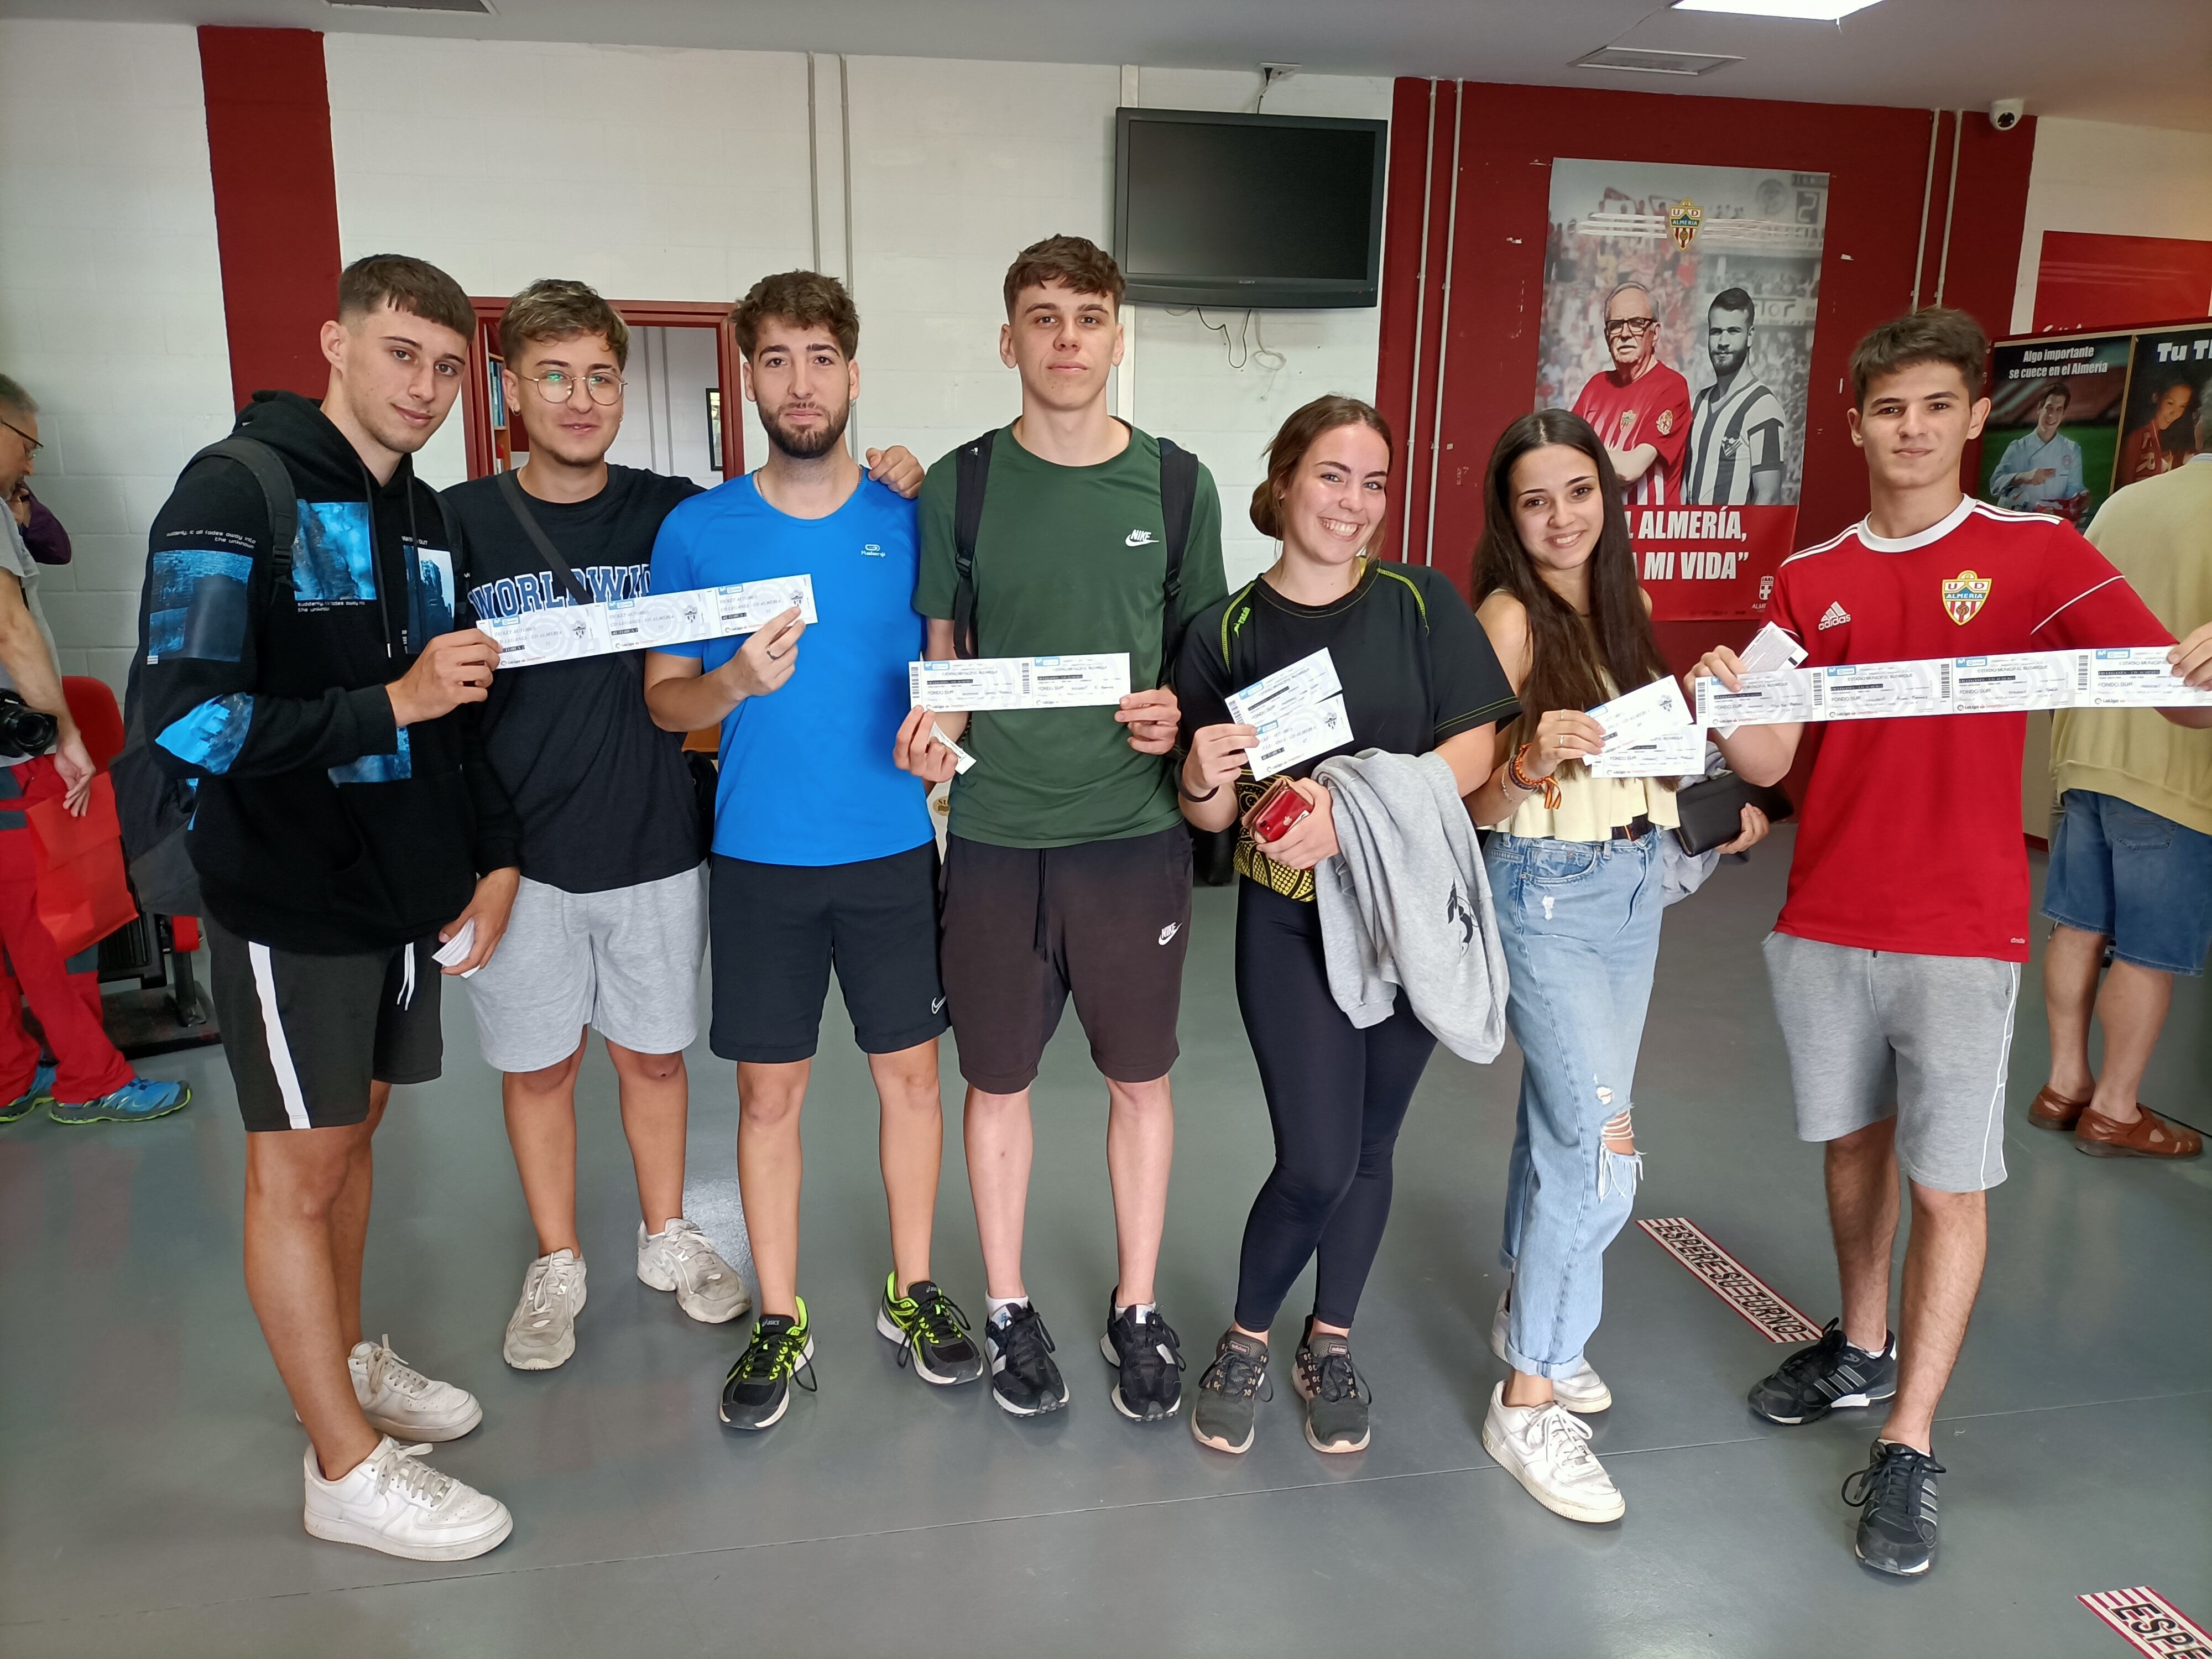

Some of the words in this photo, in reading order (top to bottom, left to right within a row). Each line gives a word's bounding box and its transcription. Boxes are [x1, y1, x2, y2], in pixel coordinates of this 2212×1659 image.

[2023, 349, 2042, 363] Algo
[2044, 346, 2094, 362] importante
[2157, 342, 2187, 362] Tu
[2008, 369, 2019, 379] se
[2021, 367, 2047, 379] cuece
[2049, 366, 2059, 377] en
[2062, 364, 2070, 375] el
[2072, 360, 2107, 375] Almería
[1637, 506, 1747, 542] ALMERÍA,
[226, 532, 243, 540] away
[1130, 529, 1151, 541] NIKE
[1644, 552, 1675, 580] MI
[1818, 614, 1851, 630] adidas
[1161, 922, 1176, 938] NIKE
[1653, 1224, 1730, 1270] ESPERE
[1708, 1271, 1755, 1288] SU
[1733, 1291, 1808, 1334] TURNO
